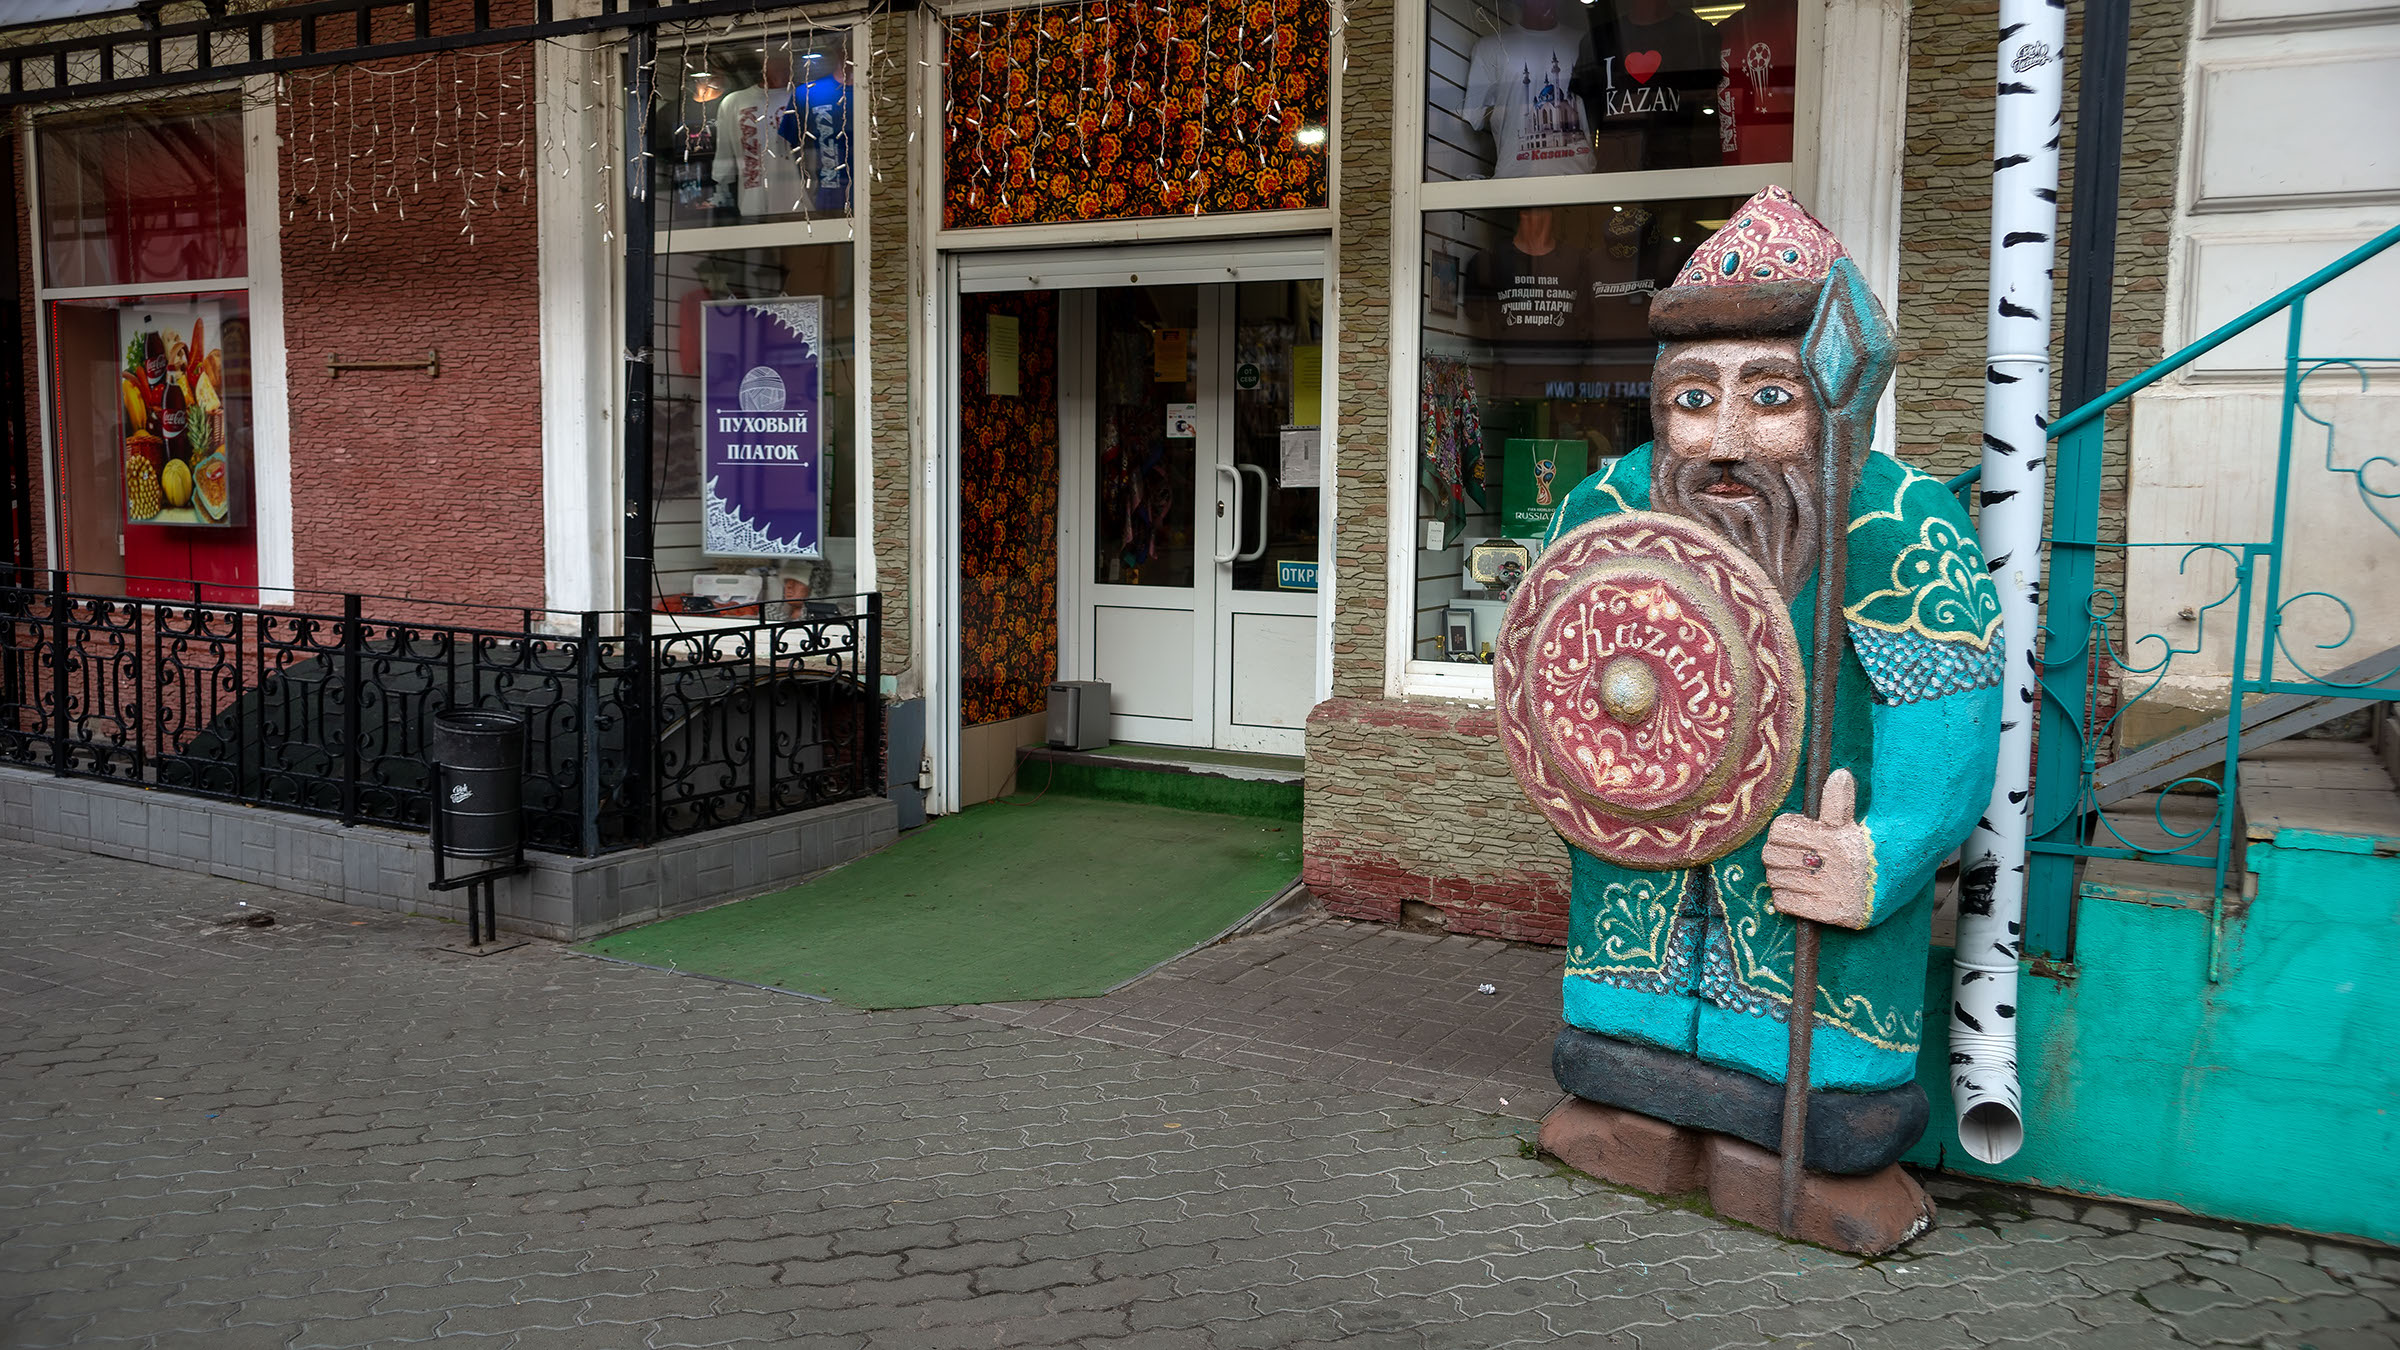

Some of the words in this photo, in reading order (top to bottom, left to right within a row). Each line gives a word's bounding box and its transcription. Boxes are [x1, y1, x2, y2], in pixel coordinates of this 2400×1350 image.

[1605, 56, 1616, 90] I
[1605, 86, 1681, 116] KAZAN
[740, 106, 761, 189] KAZAN
[812, 104, 838, 189] KAZAN
[1531, 149, 1575, 161] Казань
[1514, 275, 1536, 285] вот
[1538, 275, 1559, 285] так
[1497, 288, 1544, 300] выглядит
[1516, 315, 1523, 324] в
[1524, 314, 1553, 326] мире!
[719, 413, 808, 433] ПУХОВЫЙ
[727, 444, 799, 460] ПЛАТОК
[1515, 511, 1550, 520] RUSSIA
[1564, 602, 1709, 713] Kazan
